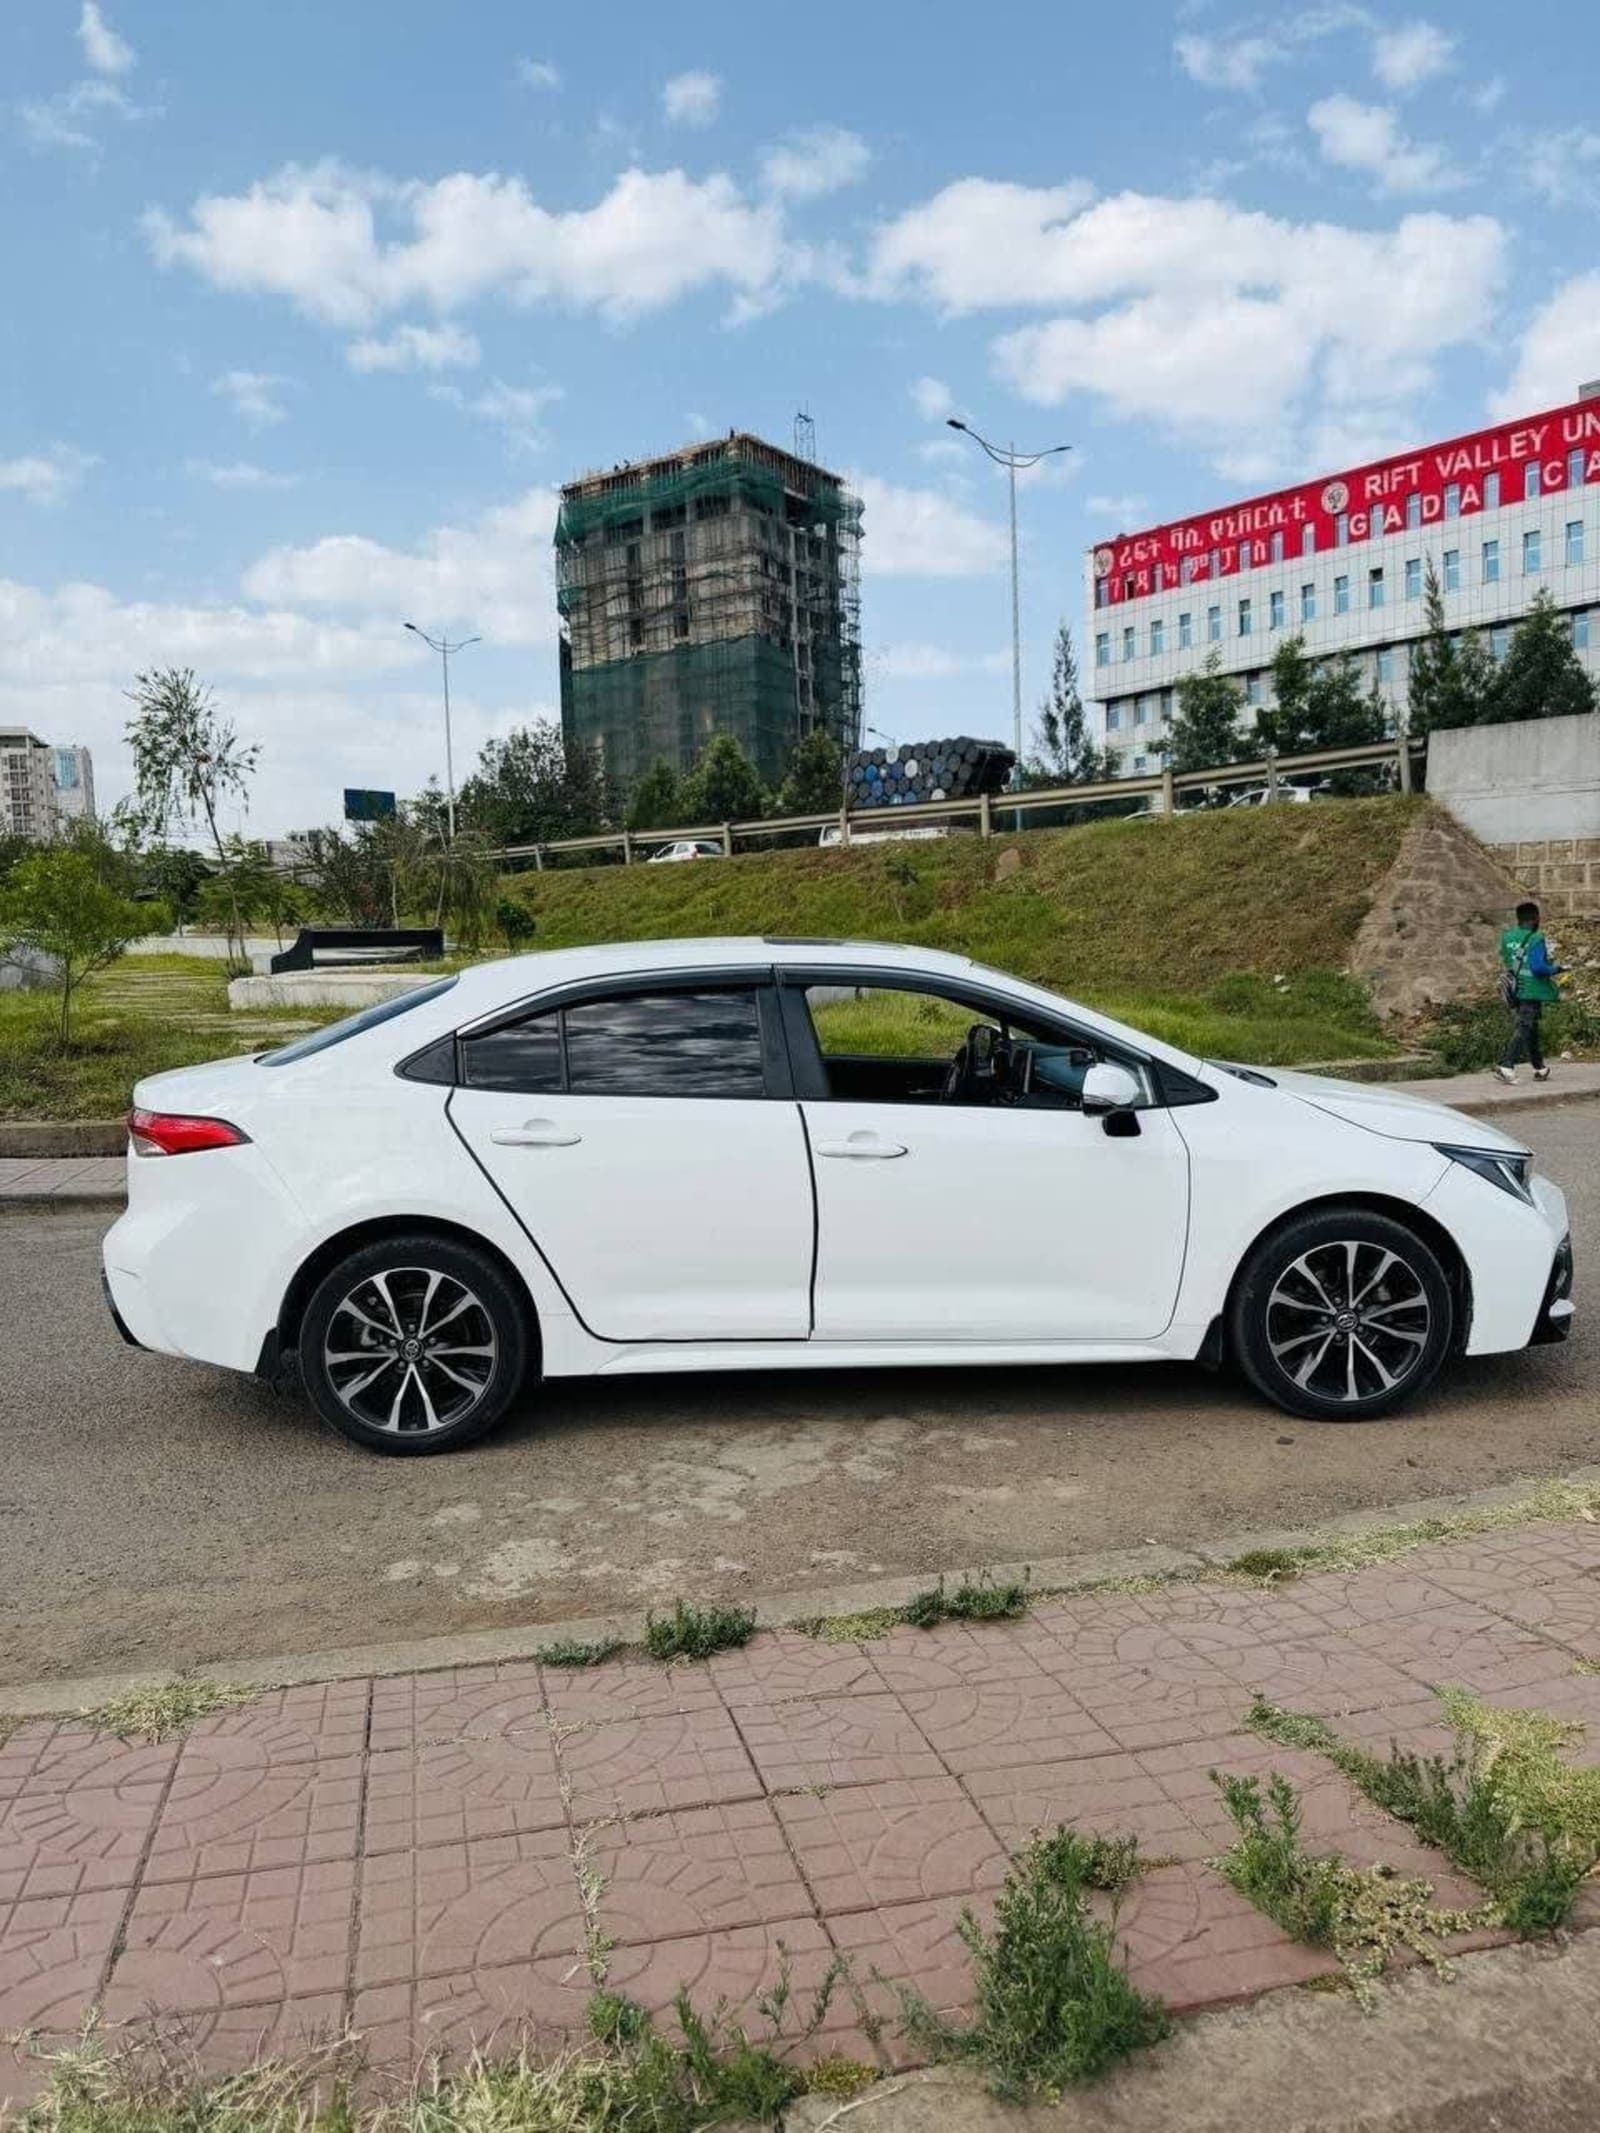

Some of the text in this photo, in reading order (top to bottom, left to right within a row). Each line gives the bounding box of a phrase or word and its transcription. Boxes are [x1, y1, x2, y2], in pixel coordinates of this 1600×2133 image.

[1364, 461, 1424, 500] RIFT
[1435, 425, 1549, 479] VALLEY
[1350, 484, 1481, 536] GADA
